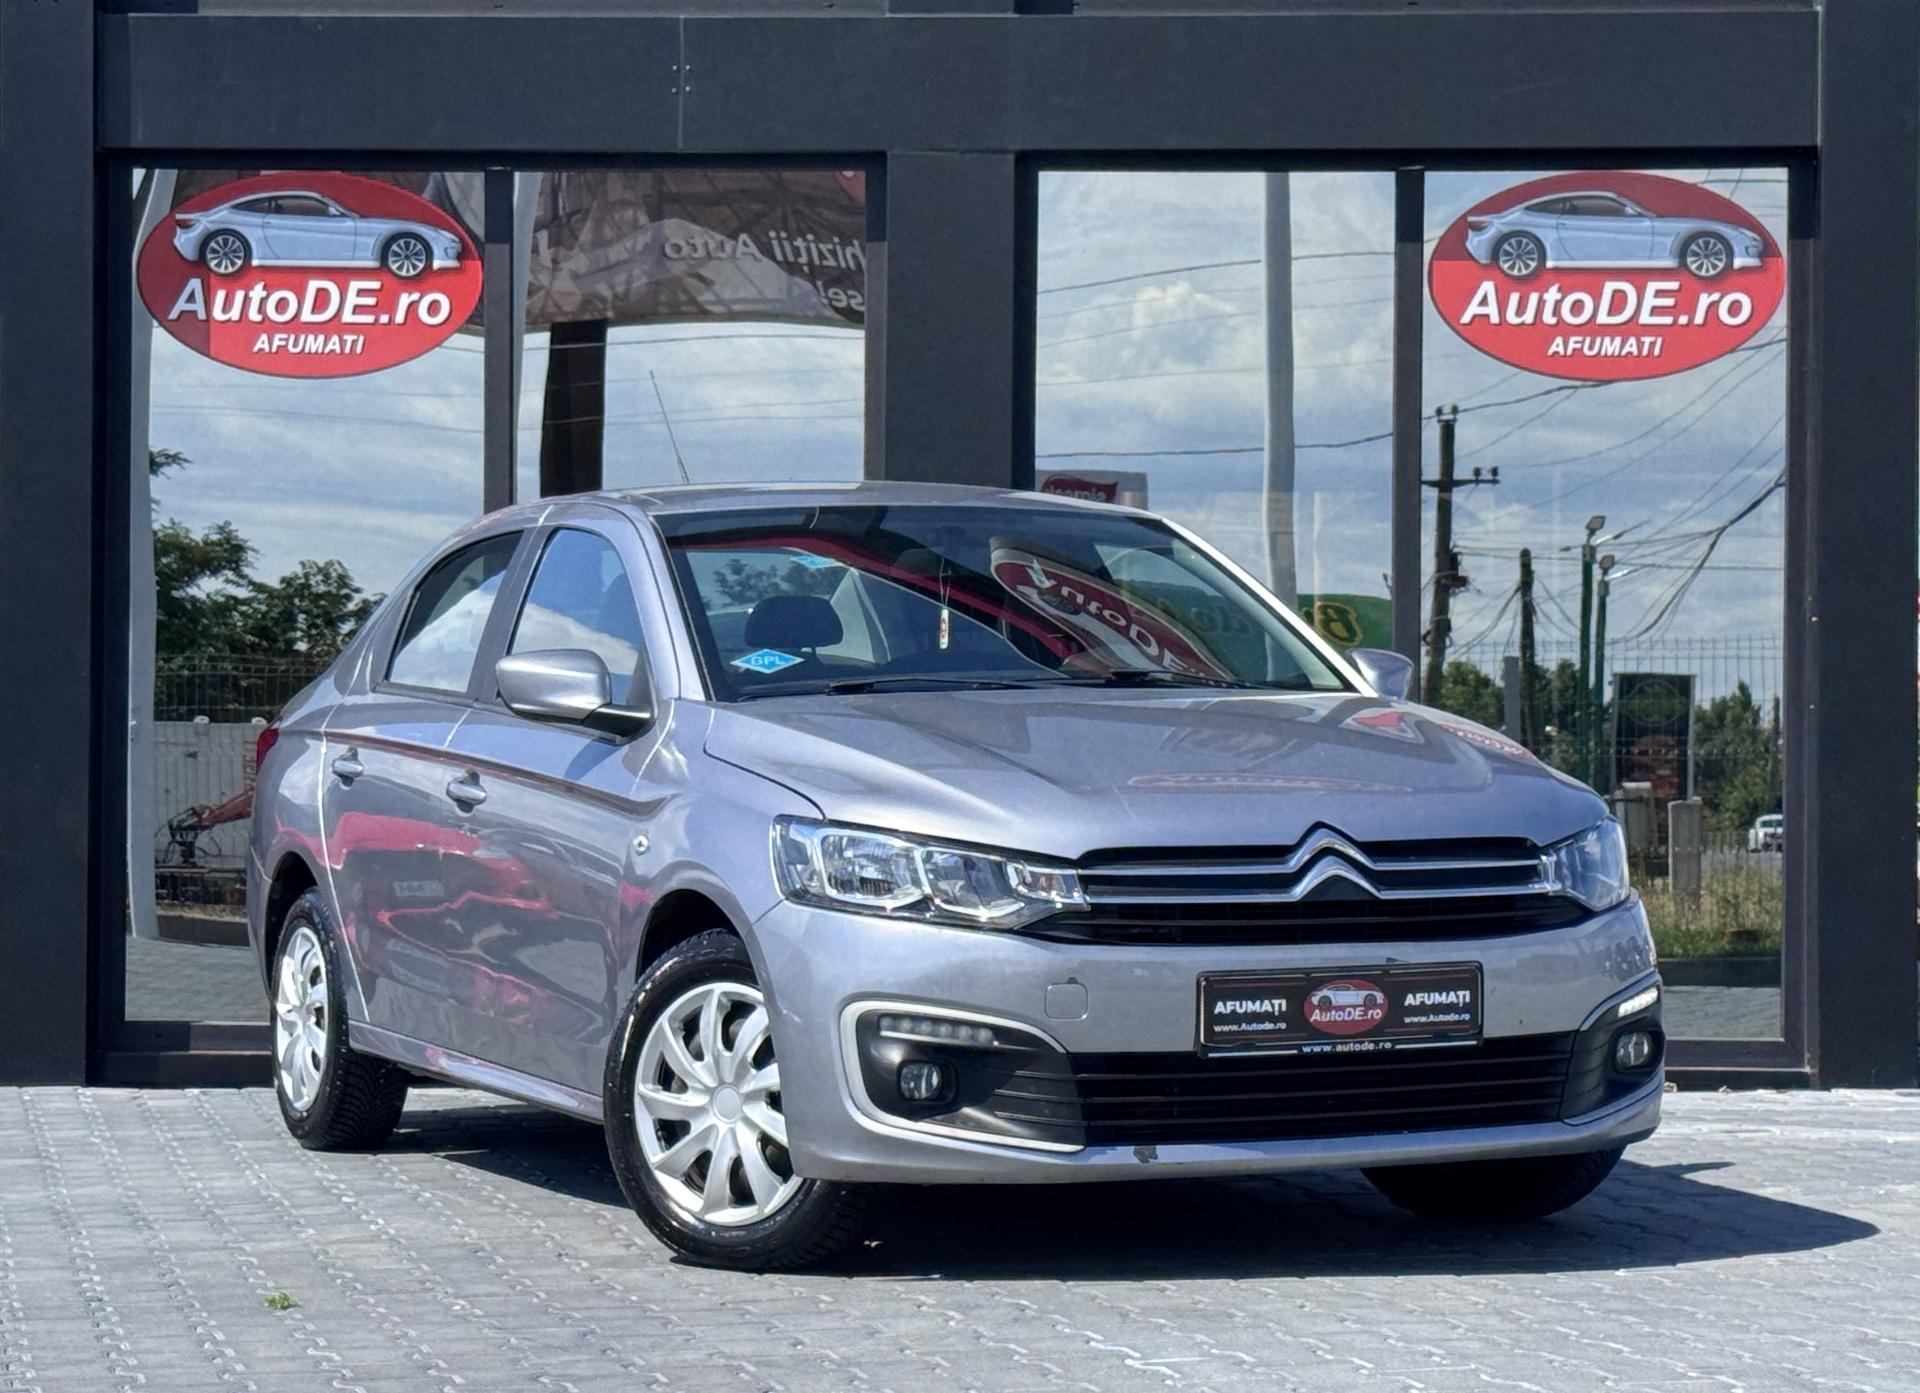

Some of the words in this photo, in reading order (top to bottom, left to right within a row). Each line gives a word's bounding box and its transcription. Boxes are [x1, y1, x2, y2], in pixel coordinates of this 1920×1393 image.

[168, 277, 451, 326] AutoDE.ro
[1459, 280, 1753, 327] AutoDE.ro
[253, 333, 365, 355] AFUMATI
[1547, 336, 1663, 357] AFUMATI
[750, 655, 786, 666] GPL
[1309, 1007, 1383, 1022] AutoDE.ro
[1301, 1041, 1393, 1053] www.autode.ro
